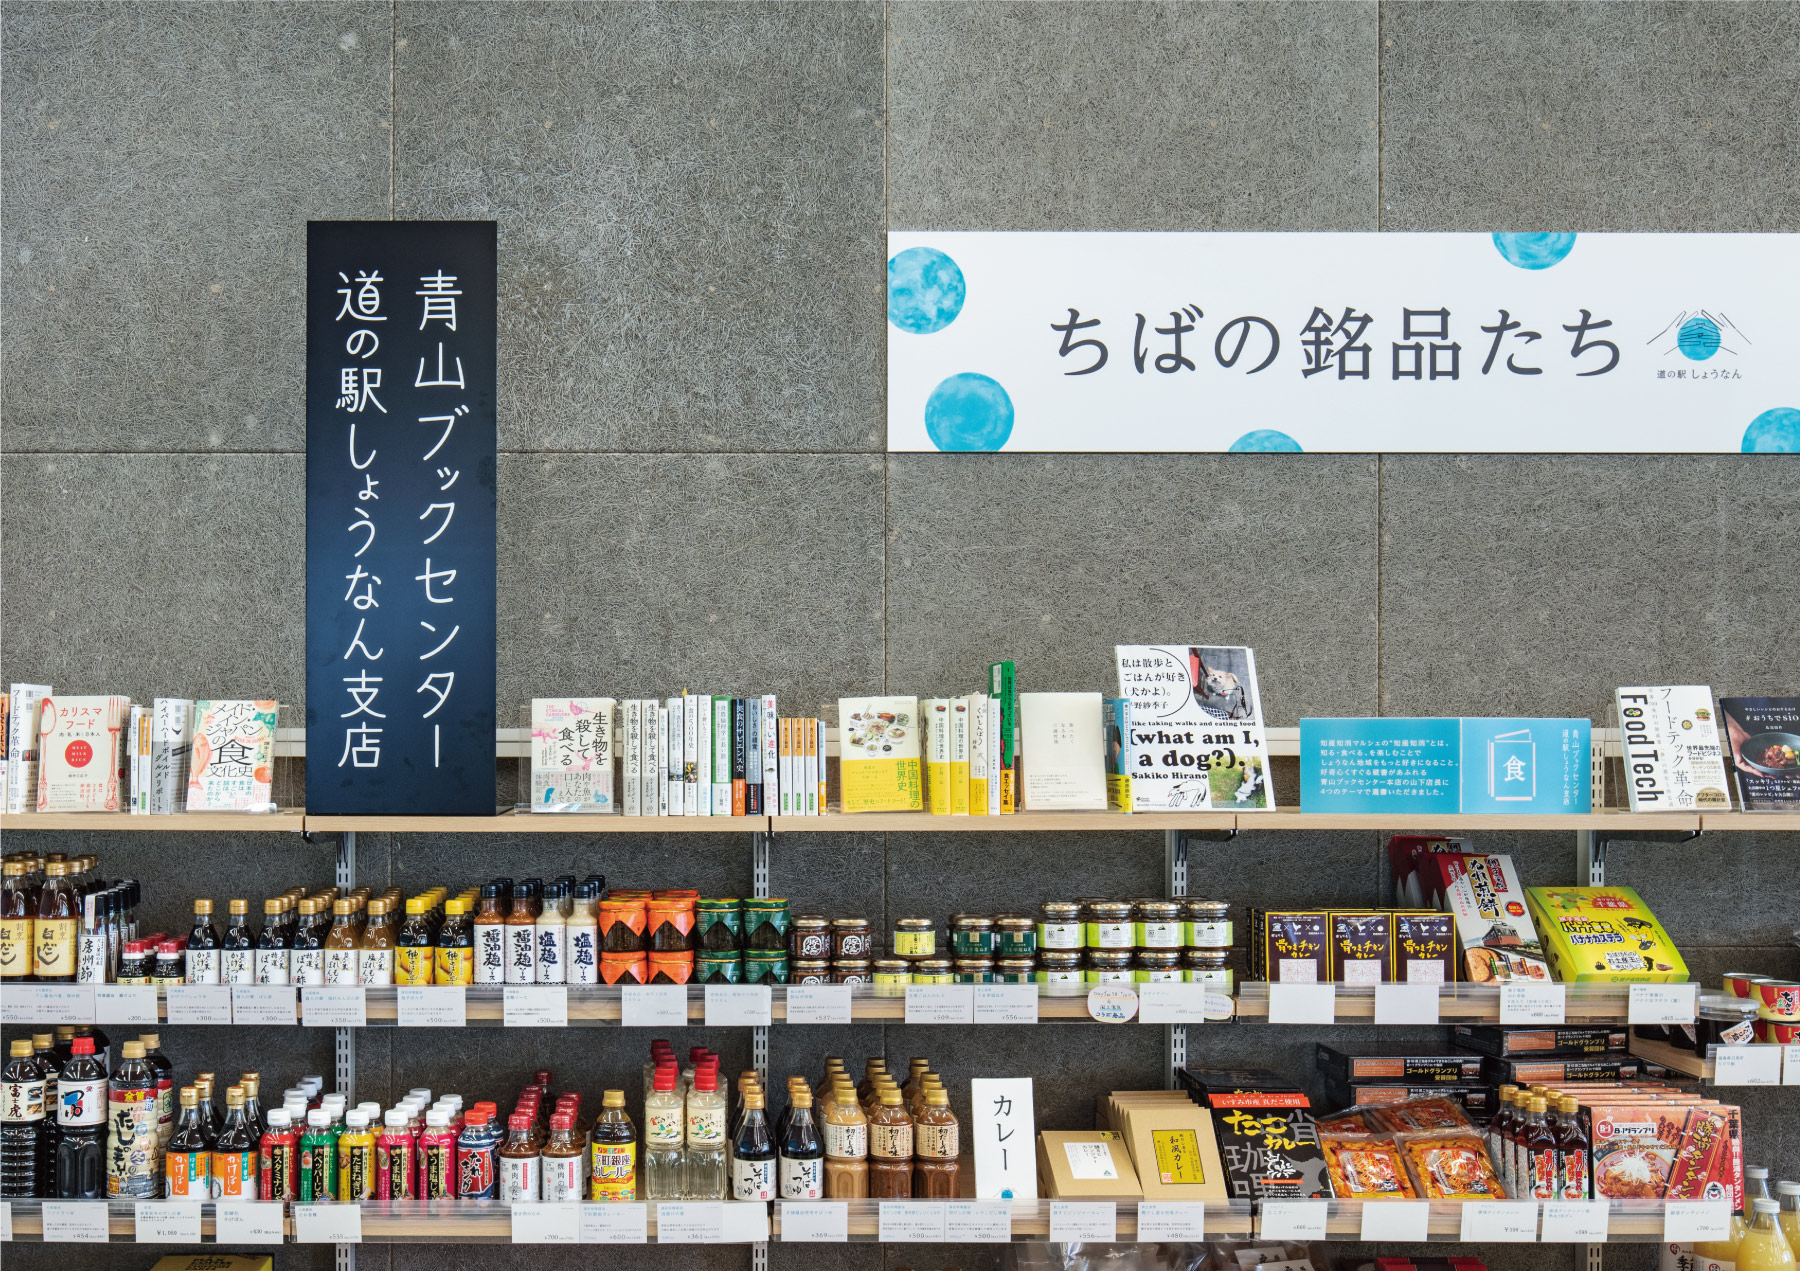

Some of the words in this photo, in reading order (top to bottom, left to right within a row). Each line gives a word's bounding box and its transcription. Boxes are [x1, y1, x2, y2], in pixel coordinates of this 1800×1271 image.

[1049, 303, 1622, 381] ちばの銘品たち
[1656, 369, 1687, 379] 道の駅
[1691, 369, 1742, 380] しょうなん
[335, 269, 388, 768] 道の駅しょうなん支店
[414, 269, 469, 768] 青山ブックセンター
[1121, 657, 1174, 669] 私は散歩と
[1123, 671, 1186, 683] ごはんが好き
[60, 706, 103, 718] カリスマ
[65, 719, 96, 730] フード
[1148, 720, 1174, 728] taking
[1214, 720, 1239, 728] eating
[1621, 694, 1655, 745] Food
[160, 700, 170, 780] ハイパーハードボイルド
[206, 724, 264, 737] ジャパン
[212, 736, 227, 745] の
[575, 719, 592, 760] 殺して
[591, 711, 608, 766] 生き物を
[630, 703, 639, 774] 生き物を殺して食べる
[648, 703, 656, 774] 生き物を殺して食べる
[766, 699, 776, 760] 美味しい進化
[1202, 732, 1236, 745] am
[1243, 730, 1261, 748] I,
[210, 739, 255, 767] 食
[558, 727, 575, 766] 食べる
[1138, 754, 1154, 767] a
[1161, 748, 1246, 771] dog?).
[1660, 687, 1694, 808] フードテック革命
[206, 765, 254, 778] 文化史
[896, 759, 908, 792] 世界史
[1131, 771, 1169, 780] Sakiko
[1171, 771, 1208, 780] Hirano
[1320, 759, 1460, 767] しょうなん地域をもっと好きになること。
[1320, 768, 1427, 776] 好奇心くすぐる蔵書があふれる
[1502, 754, 1527, 782] 食
[1561, 729, 1570, 806] 道の駅しょうなん支店
[1571, 729, 1580, 806] 青山ブックセンター
[1631, 749, 1665, 802] Tech
[154, 753, 164, 813] グルメリポート
[564, 773, 573, 802] 口に入る
[573, 772, 582, 802] あなたの
[582, 772, 592, 802] 肉や魚が
[907, 759, 921, 809] 中国料理の
[1320, 778, 1449, 786] 青山ブックセンター本店の山下店長に
[1320, 788, 1444, 796] 4つのテーマで選書いただきました。
[1468, 858, 1501, 918] ぬれ煎餅
[36, 927, 60, 966] 白だし
[1275, 939, 1320, 953] 骨つきチキン
[1340, 939, 1385, 953] 骨つきチキン
[1403, 940, 1448, 954] 骨つきチキン
[1570, 933, 1624, 945] バナナカステラ
[80, 938, 95, 983] 房州節
[196, 951, 205, 983] かけつけ
[230, 951, 239, 983] かけつけ
[1290, 951, 1310, 959] カレー
[1355, 951, 1375, 959] カレー
[1418, 952, 1438, 960] カレー
[1406, 1067, 1458, 1075] ゴールドグランプリ
[1566, 1071, 1616, 1079] ゴールドグランプリ
[8, 1083, 23, 1118] 富士虎
[124, 1090, 146, 1102] 金笛
[993, 1094, 1016, 1171] カレー
[1222, 1109, 1288, 1136] たこ
[1727, 1109, 1740, 1139] 千葉県
[1263, 1133, 1316, 1151] カレー
[468, 1151, 484, 1177] たれ
[594, 1153, 632, 1167] 下町銀座
[1169, 1135, 1184, 1179] 和風カレー
[174, 1155, 187, 1194] かけぽん
[227, 1155, 240, 1194] かけぽん
[460, 1159, 473, 1193] キング
[593, 1165, 632, 1179] カレールー
[752, 1167, 763, 1190] そば
[801, 1166, 812, 1189] そば
